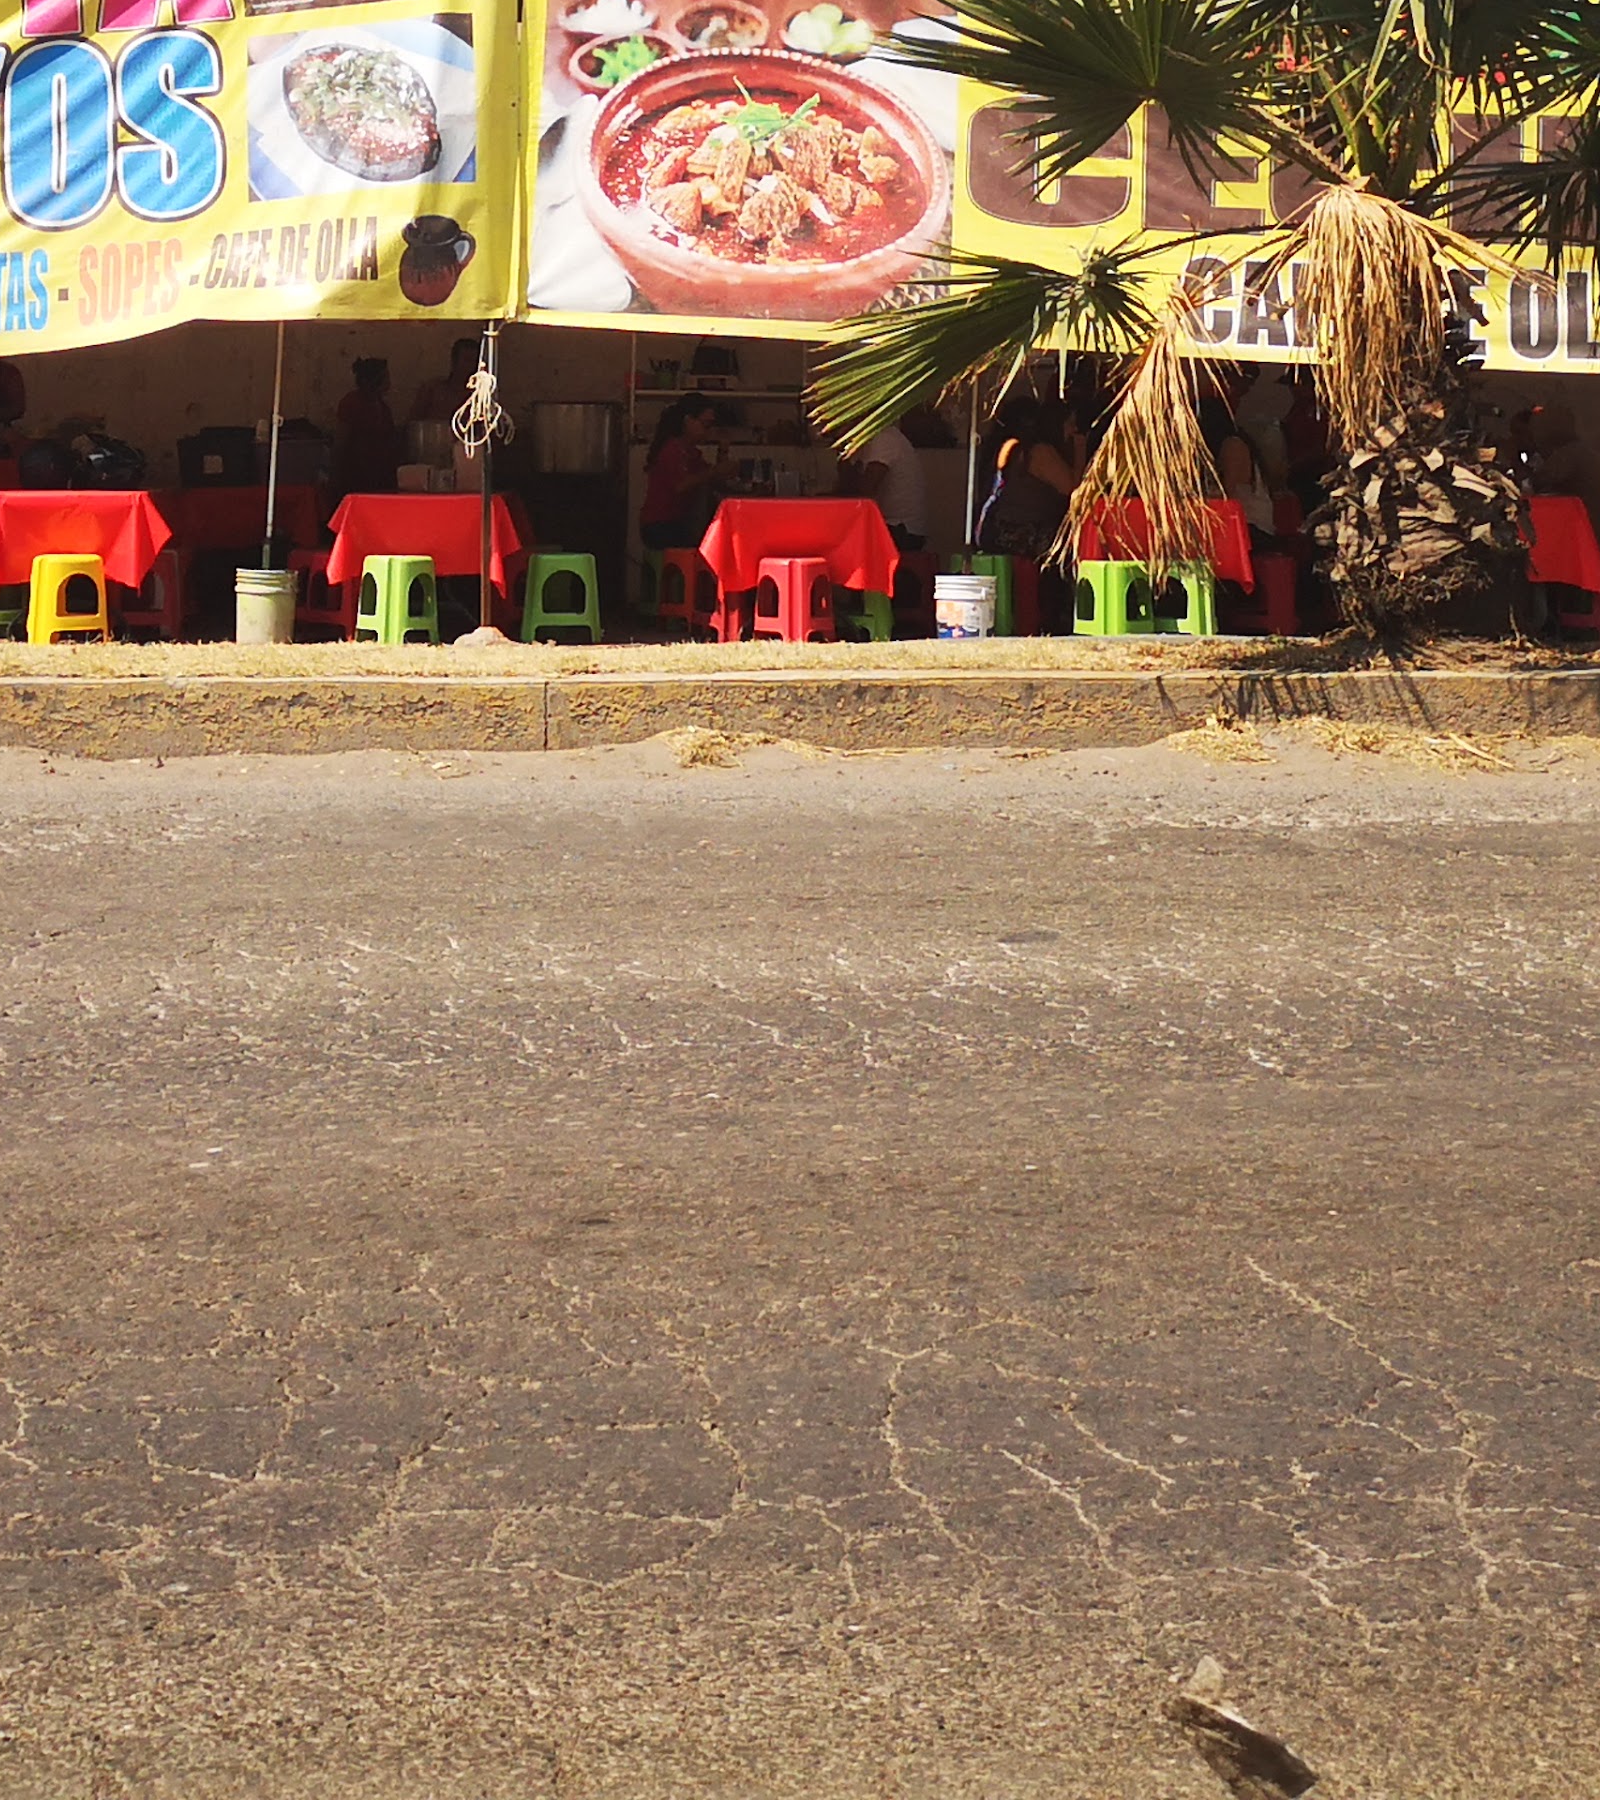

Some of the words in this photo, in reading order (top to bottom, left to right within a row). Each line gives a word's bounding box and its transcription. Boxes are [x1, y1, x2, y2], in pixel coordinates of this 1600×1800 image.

[79, 238, 183, 326] SOPES
[275, 223, 311, 286] DE
[315, 216, 378, 283] OLLA
